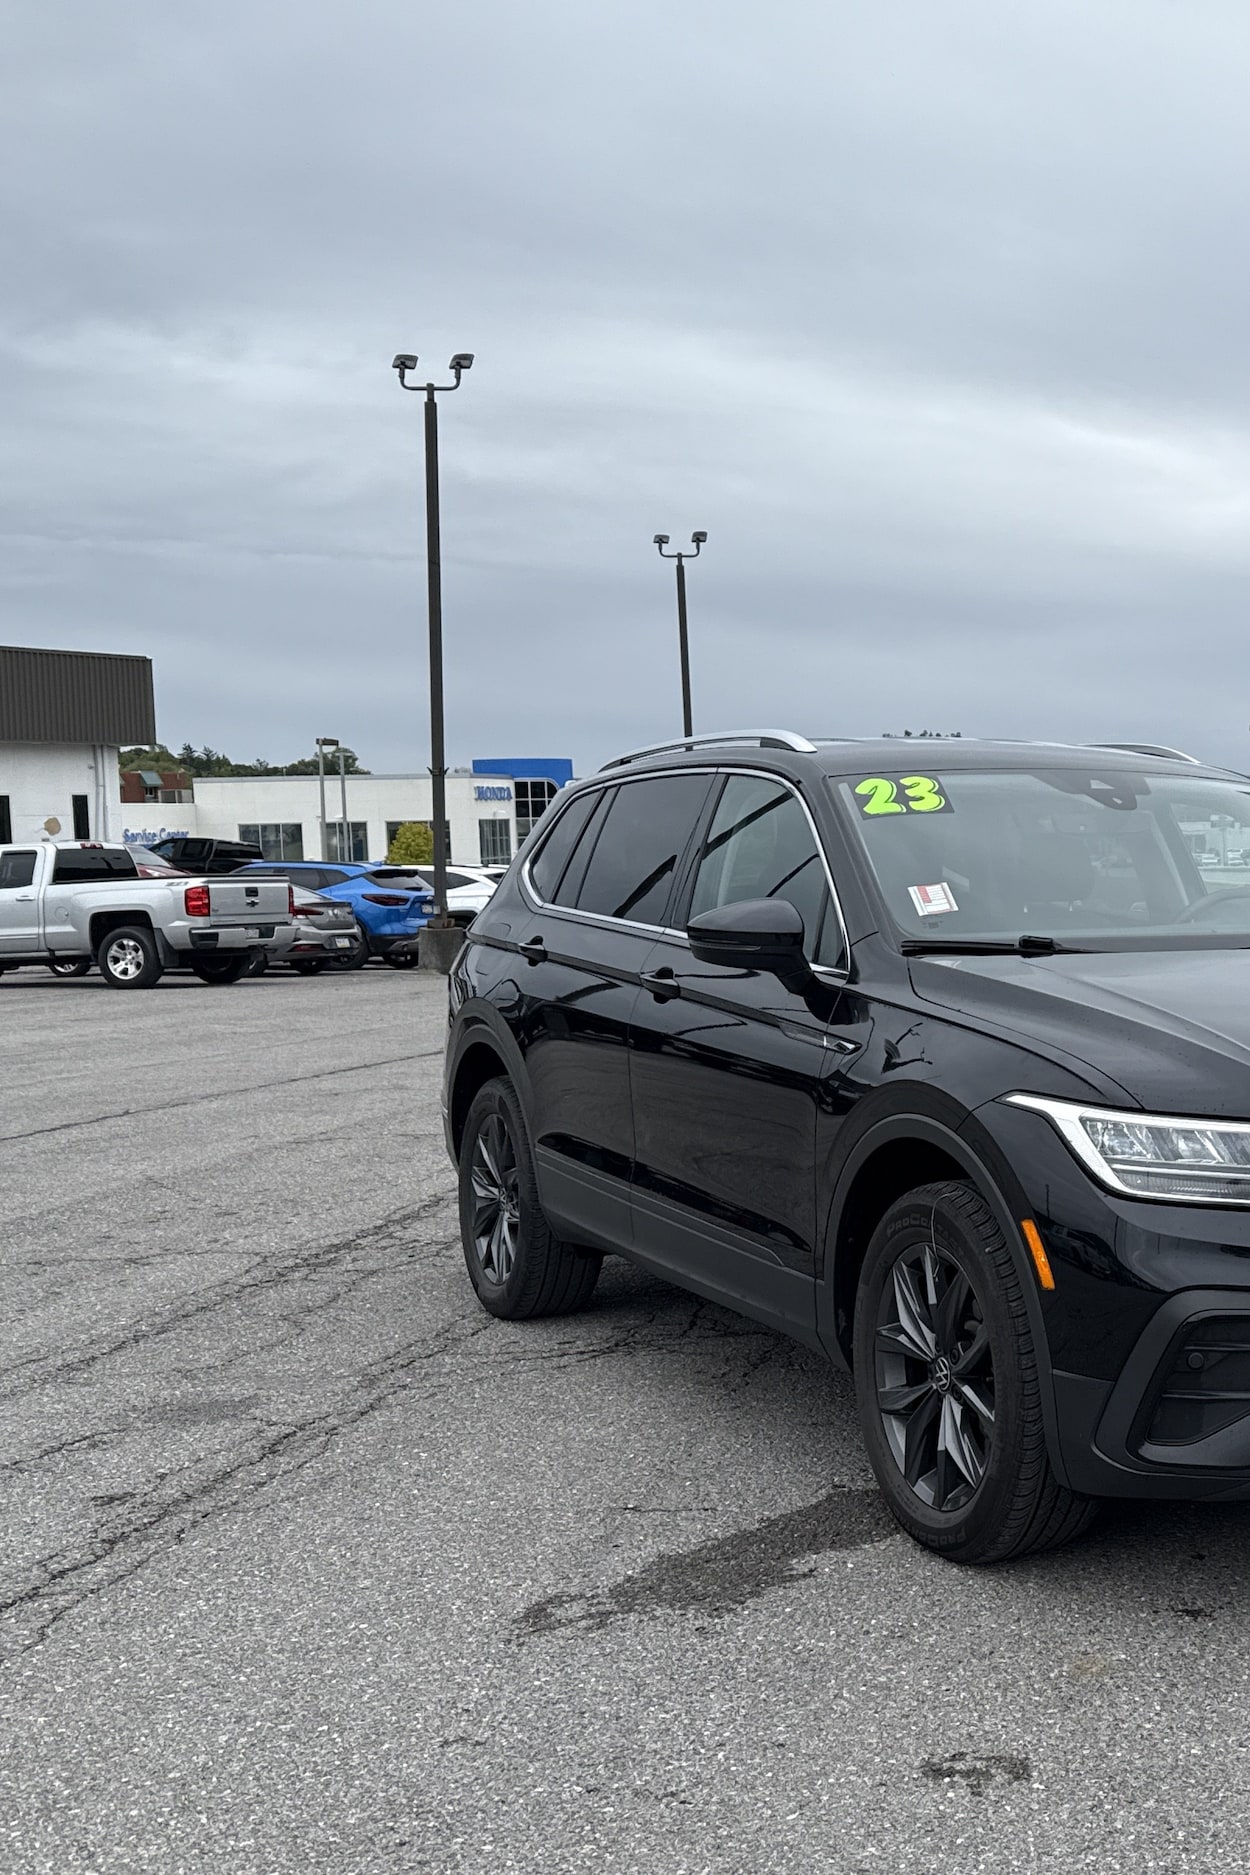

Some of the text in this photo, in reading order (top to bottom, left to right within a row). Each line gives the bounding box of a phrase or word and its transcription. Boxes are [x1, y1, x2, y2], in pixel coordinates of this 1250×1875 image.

[474, 786, 513, 801] HONDA
[855, 776, 945, 815] 23
[123, 828, 189, 843] Service Center
